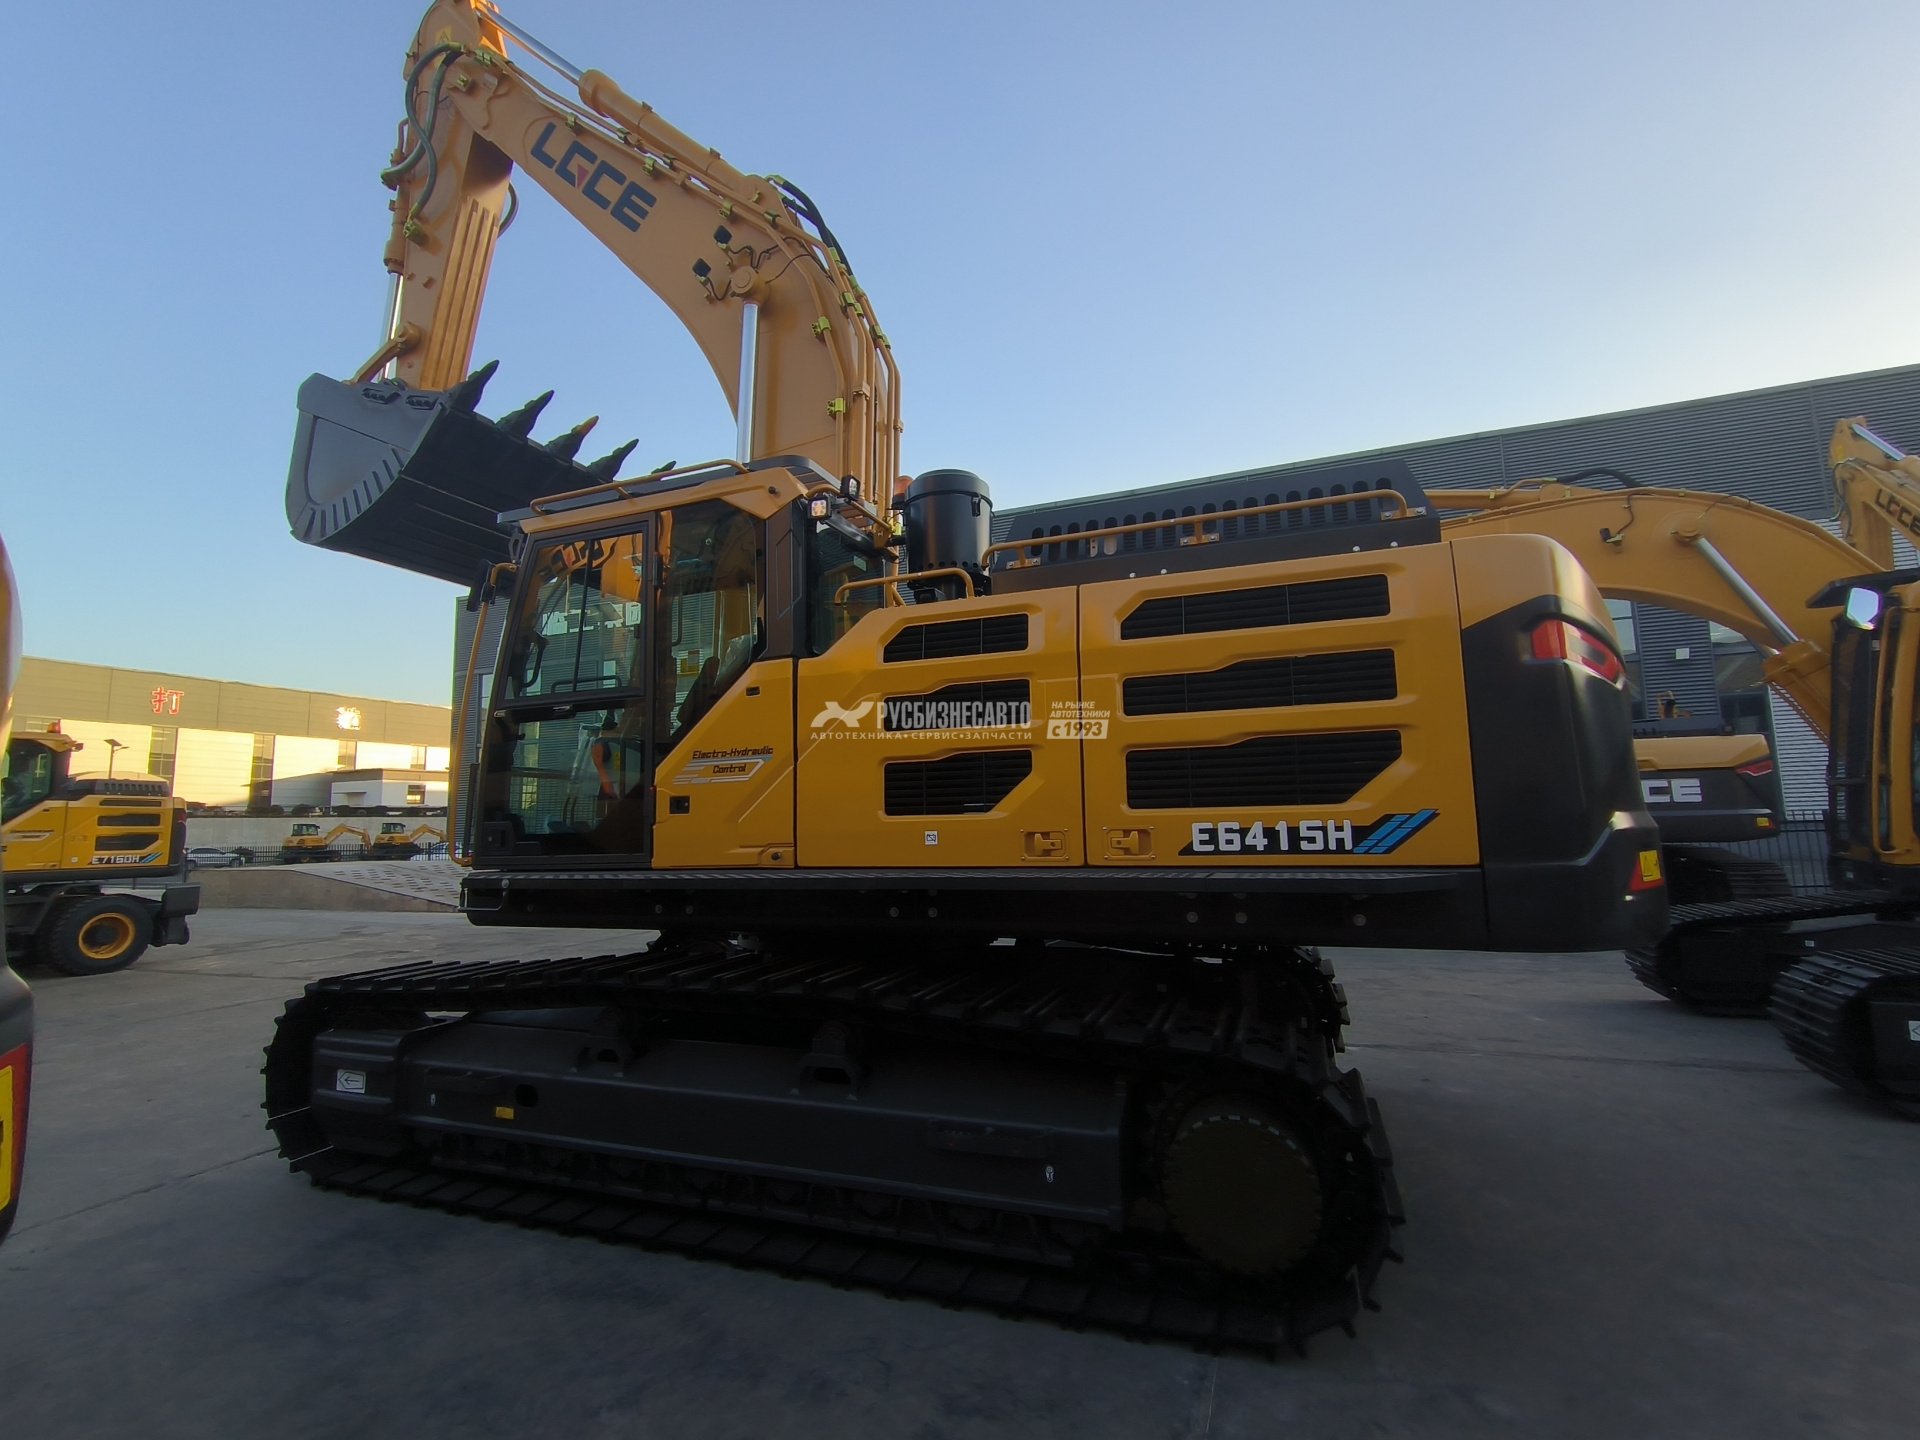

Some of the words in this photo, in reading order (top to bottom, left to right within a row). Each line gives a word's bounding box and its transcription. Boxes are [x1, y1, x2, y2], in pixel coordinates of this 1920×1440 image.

[530, 121, 657, 233] LGCE
[692, 746, 774, 759] Electro-Hydraulic
[712, 764, 747, 774] Control
[1191, 819, 1353, 852] E6415H
